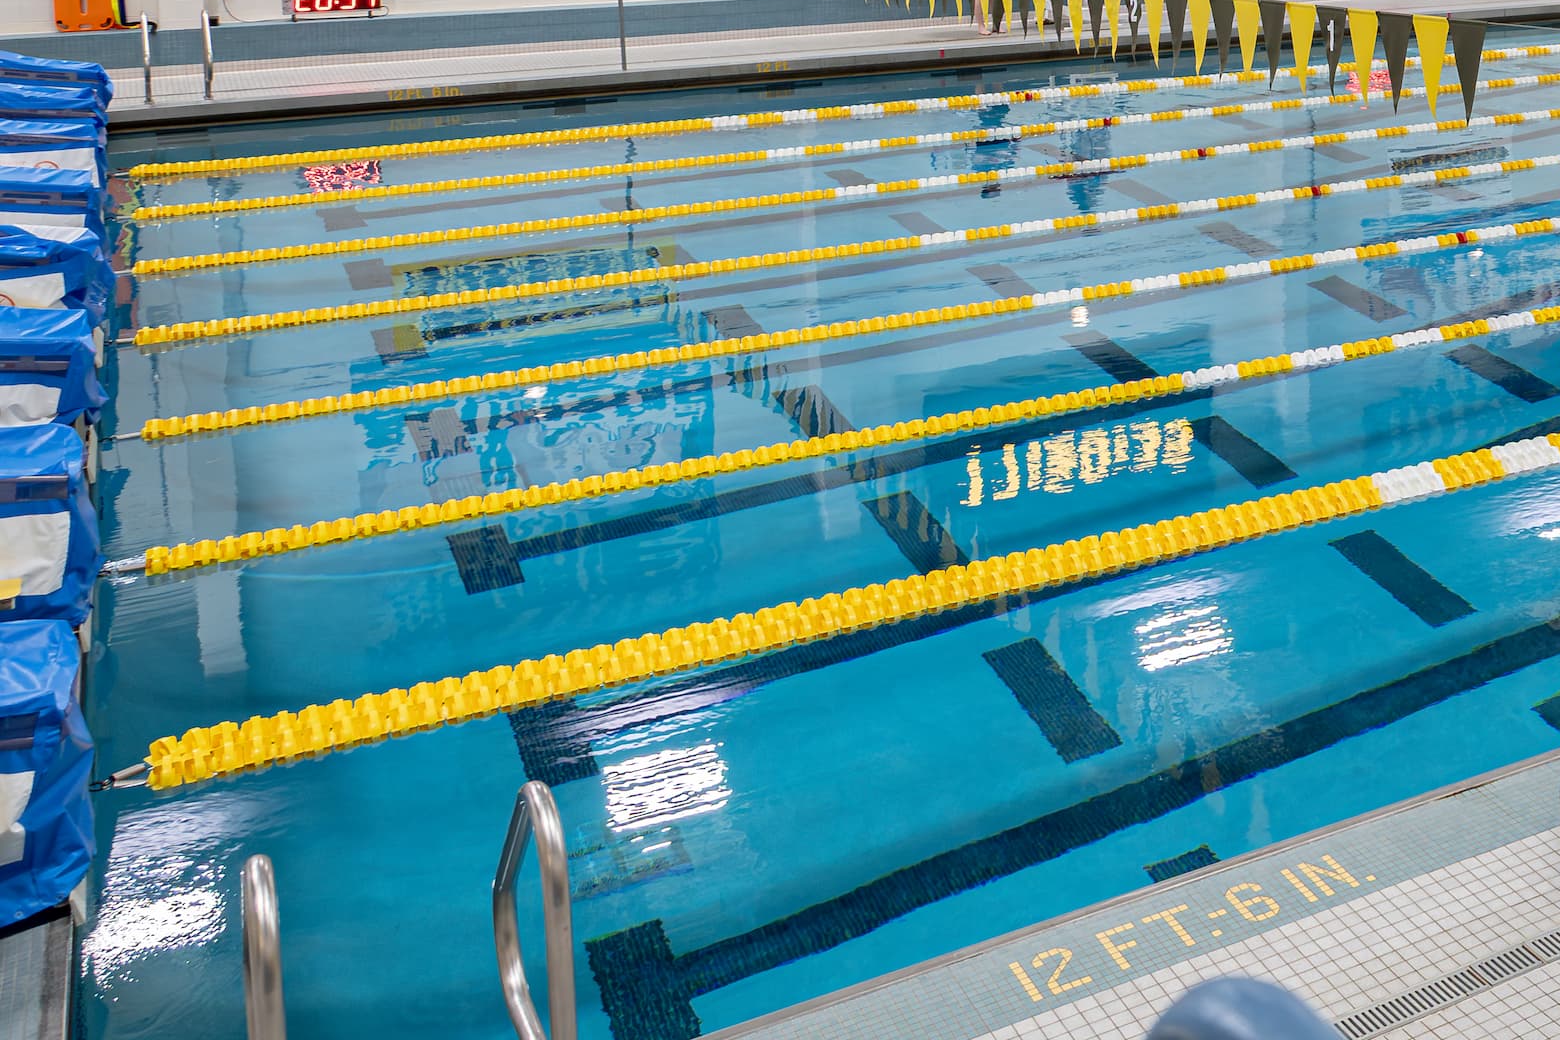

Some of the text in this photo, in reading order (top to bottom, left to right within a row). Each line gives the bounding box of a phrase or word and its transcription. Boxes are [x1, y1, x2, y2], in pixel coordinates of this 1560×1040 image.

[1326, 19, 1335, 52] 1
[387, 89, 403, 101] 12
[431, 86, 441, 97] 6
[1008, 946, 1093, 1003] 12
[1280, 853, 1378, 903] IN.
